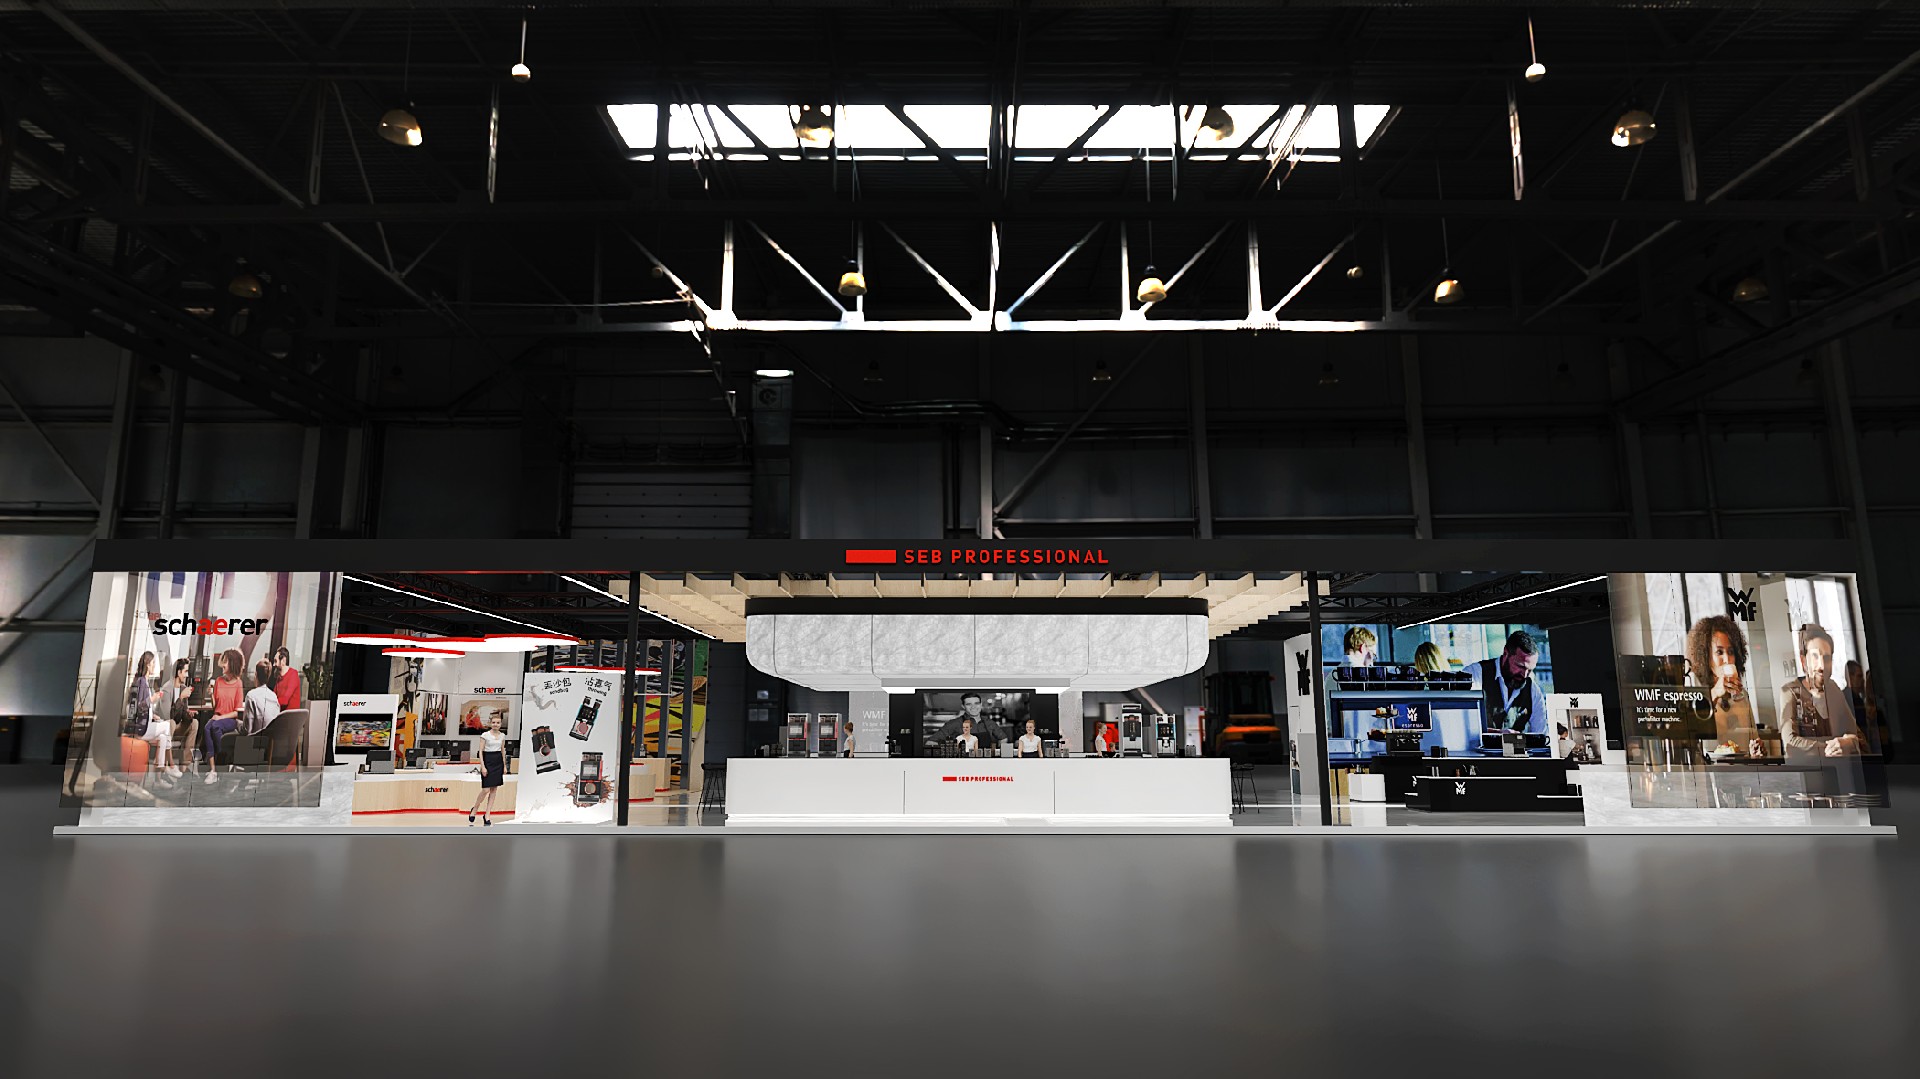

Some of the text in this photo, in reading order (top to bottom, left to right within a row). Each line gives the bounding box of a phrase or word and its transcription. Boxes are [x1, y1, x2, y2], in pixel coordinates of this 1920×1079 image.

[904, 549, 1109, 564] SEB PROFESSIONAL
[152, 612, 268, 635] schaerer
[1634, 688, 1704, 704] WMF espresso
[862, 710, 886, 719] WMF
